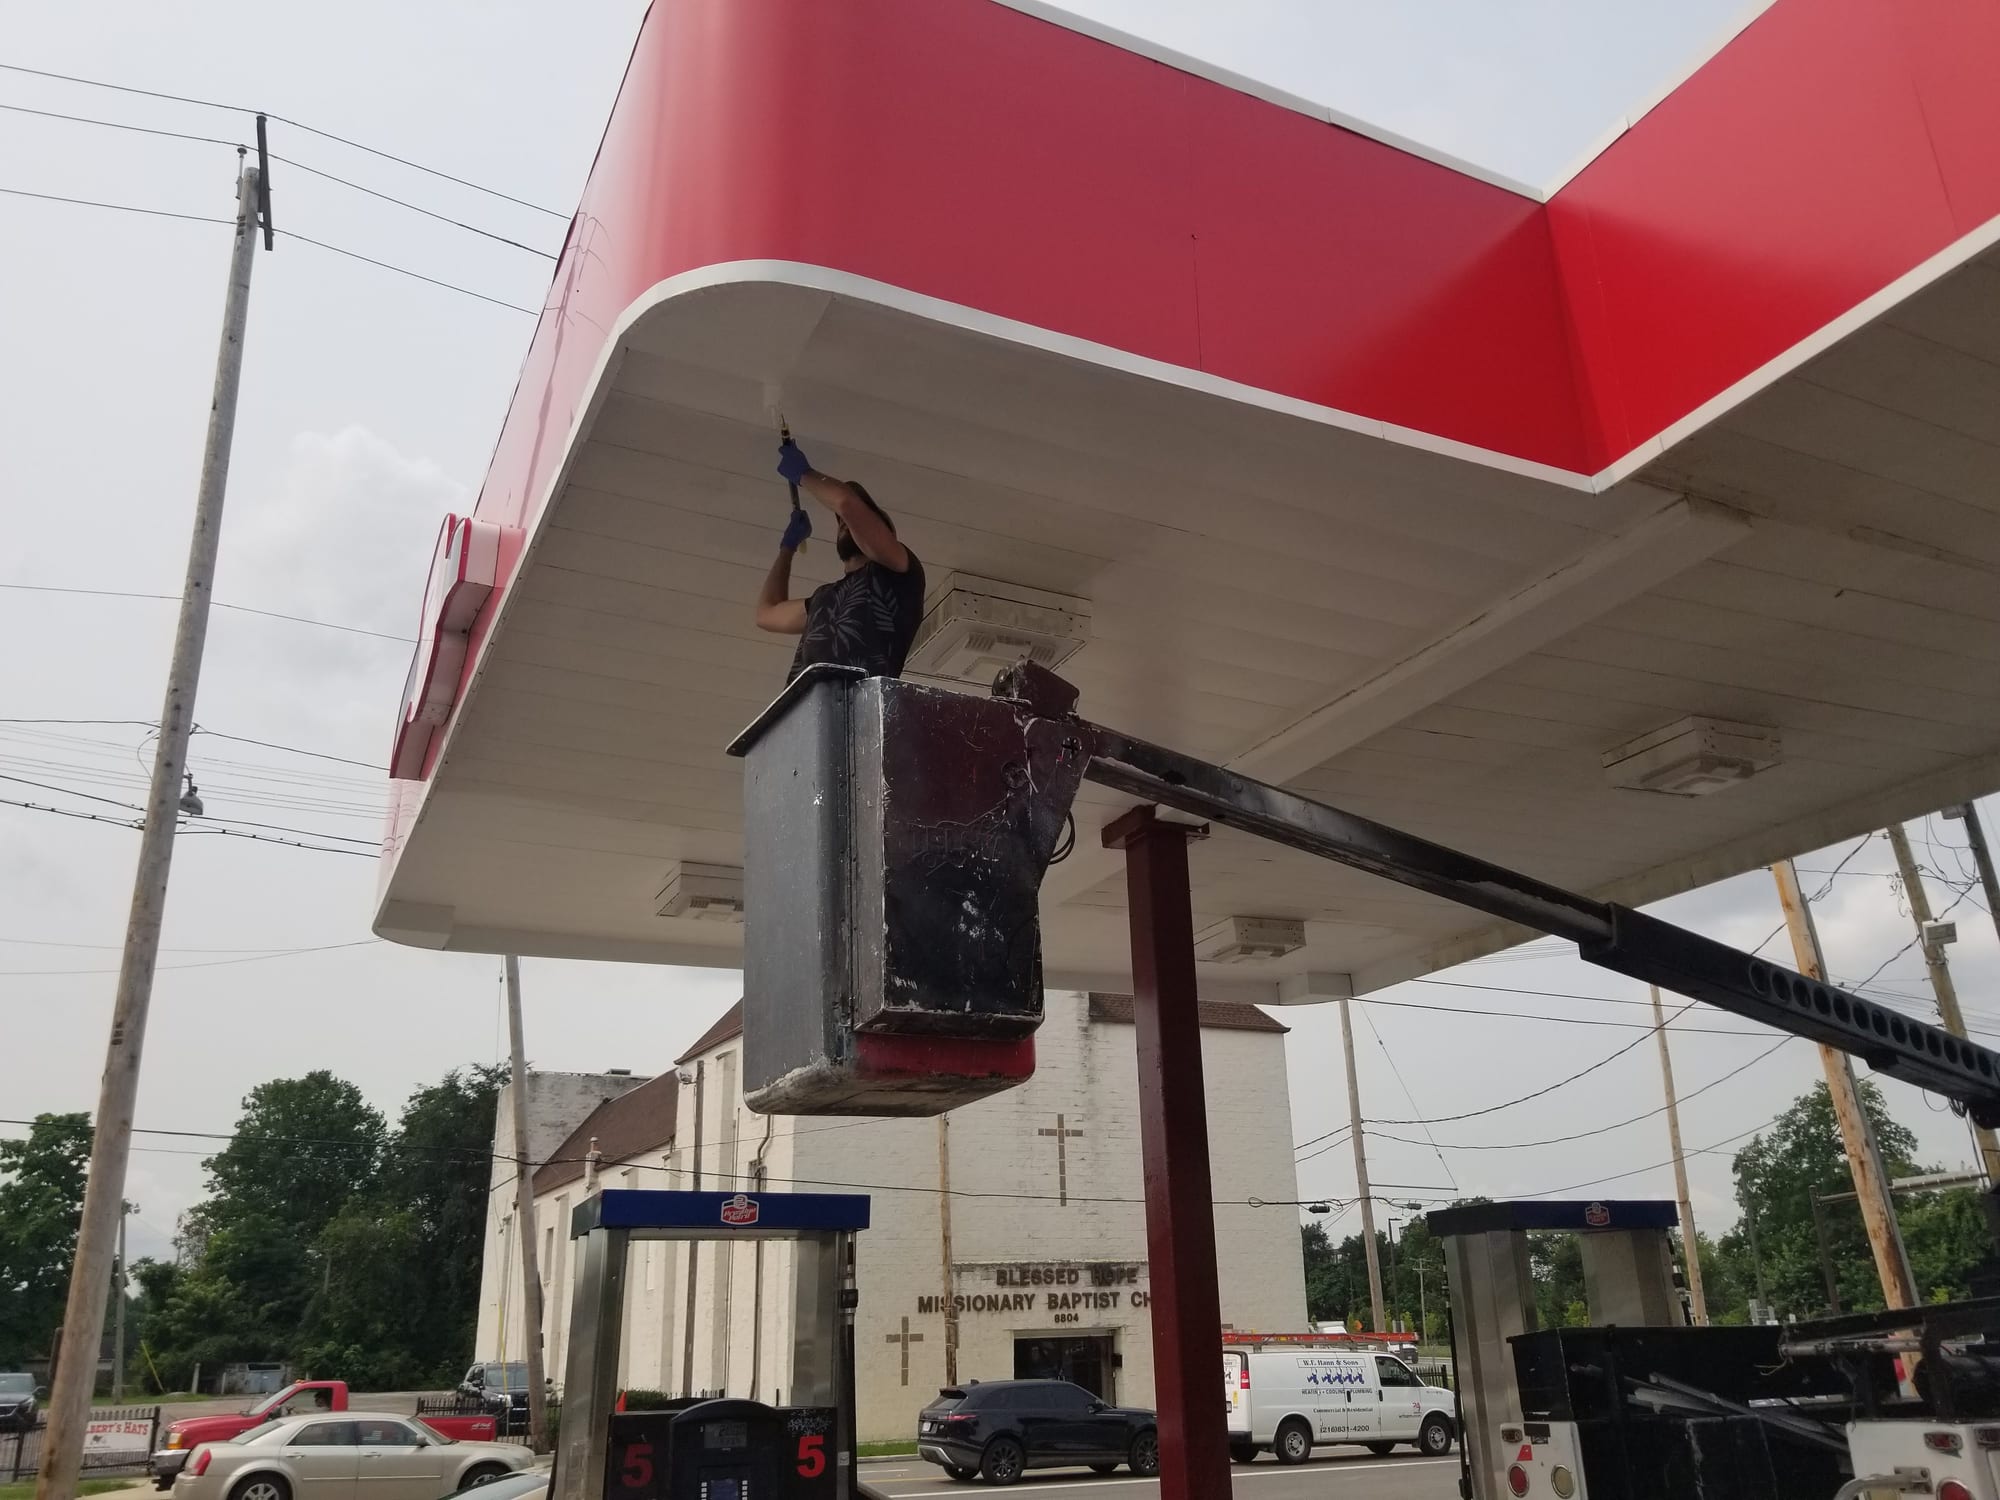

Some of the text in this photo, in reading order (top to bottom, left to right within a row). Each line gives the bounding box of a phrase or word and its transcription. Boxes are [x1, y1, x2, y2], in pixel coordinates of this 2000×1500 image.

[996, 1268, 1080, 1286] BLESSED
[1047, 1291, 1121, 1309] BAPTIST
[1054, 1313, 1079, 1323] 8804
[622, 1443, 654, 1488] 5
[796, 1435, 826, 1478] 5
